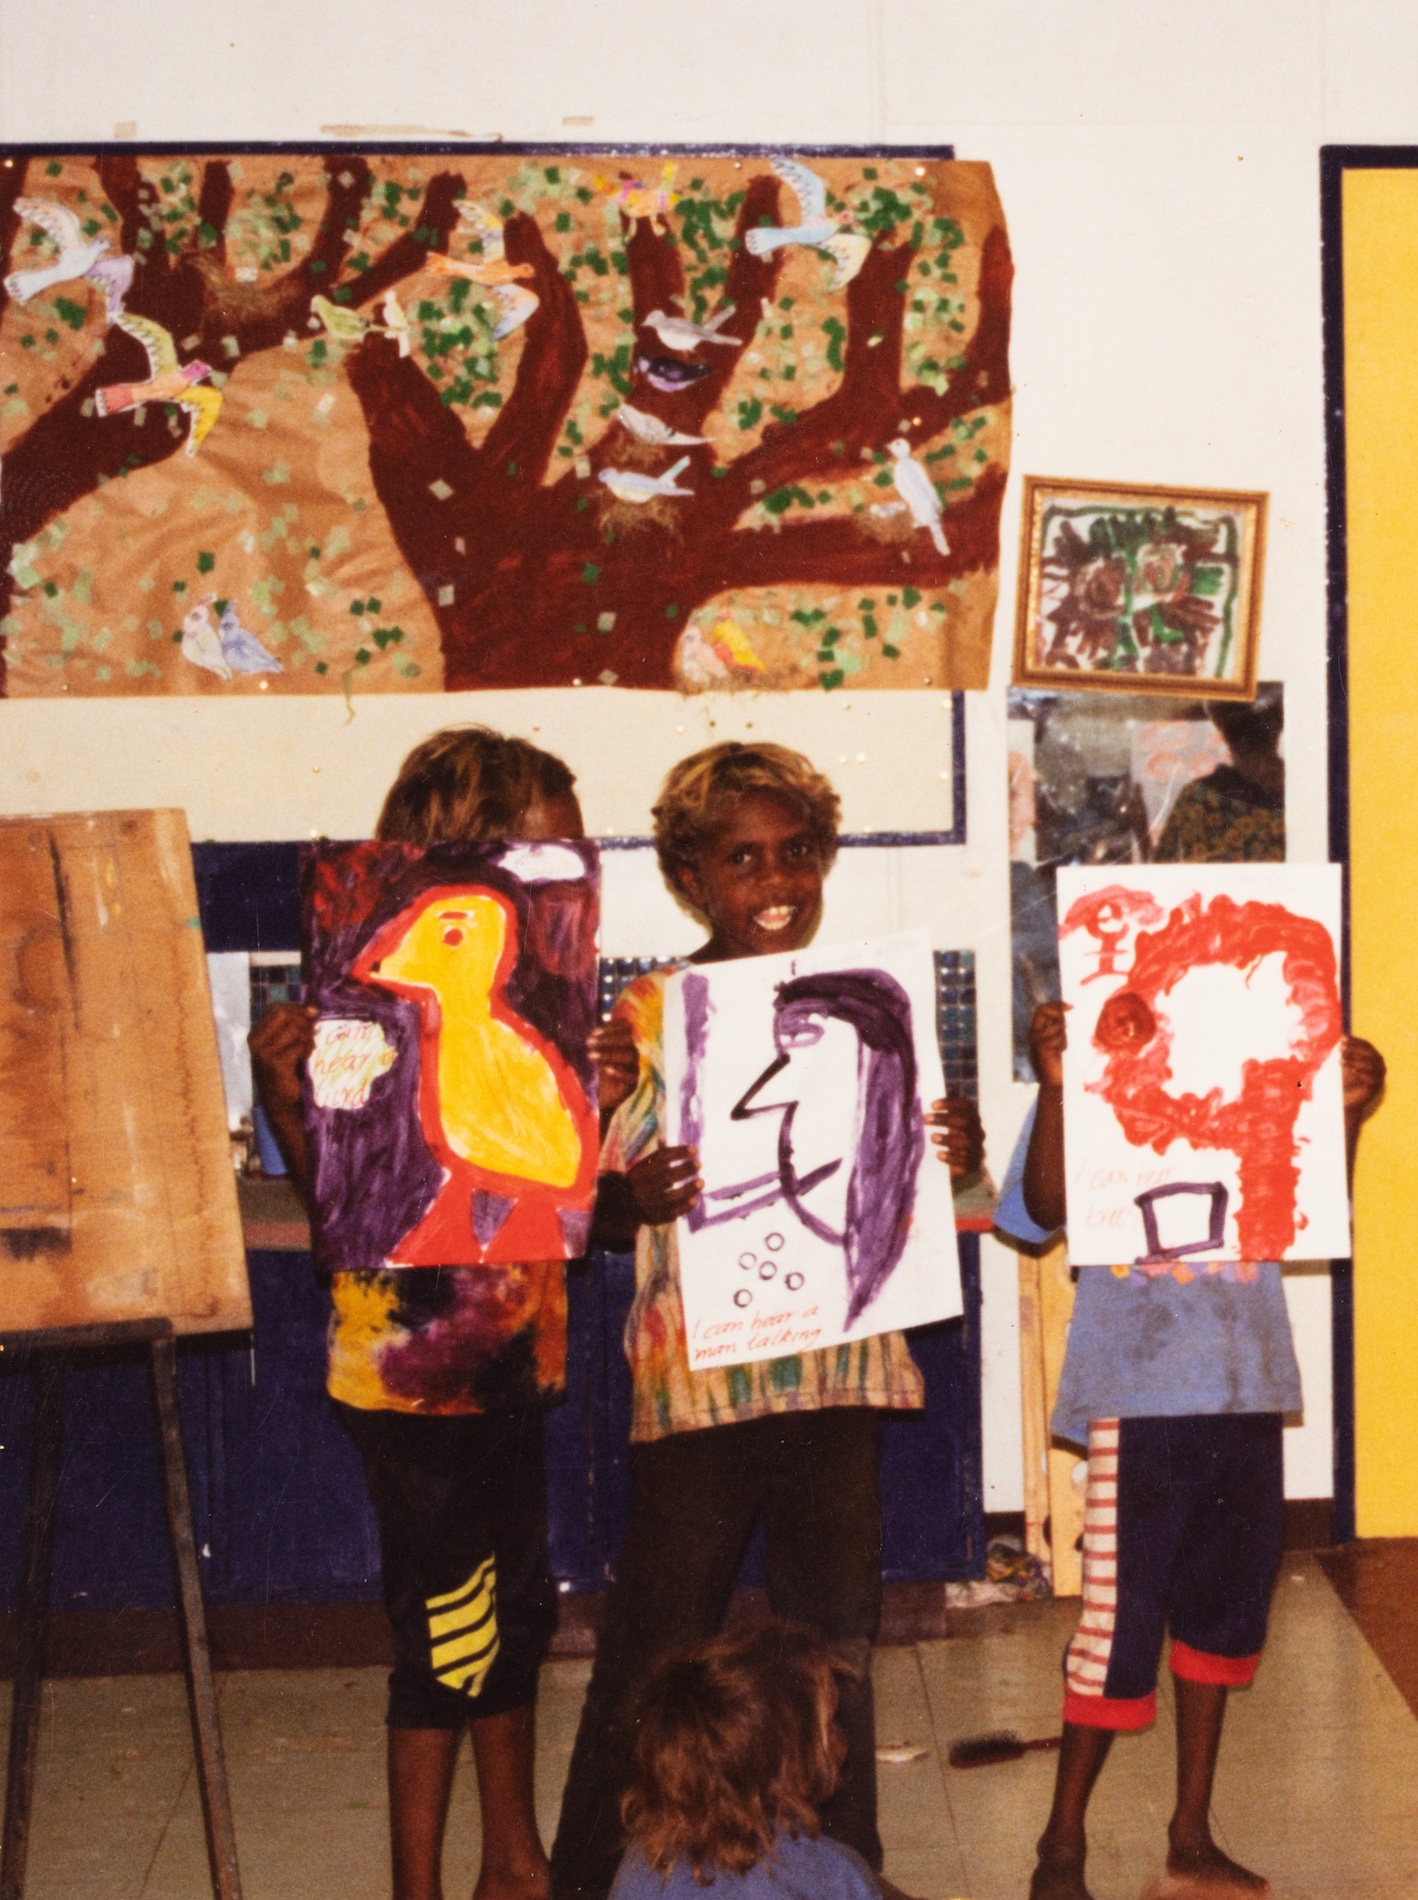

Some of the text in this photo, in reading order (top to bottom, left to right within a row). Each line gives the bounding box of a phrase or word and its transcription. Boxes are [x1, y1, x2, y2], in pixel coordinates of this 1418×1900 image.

[313, 1047, 371, 1076] hear
[692, 1305, 820, 1341] I can hear a
[694, 1327, 824, 1362] man talking
